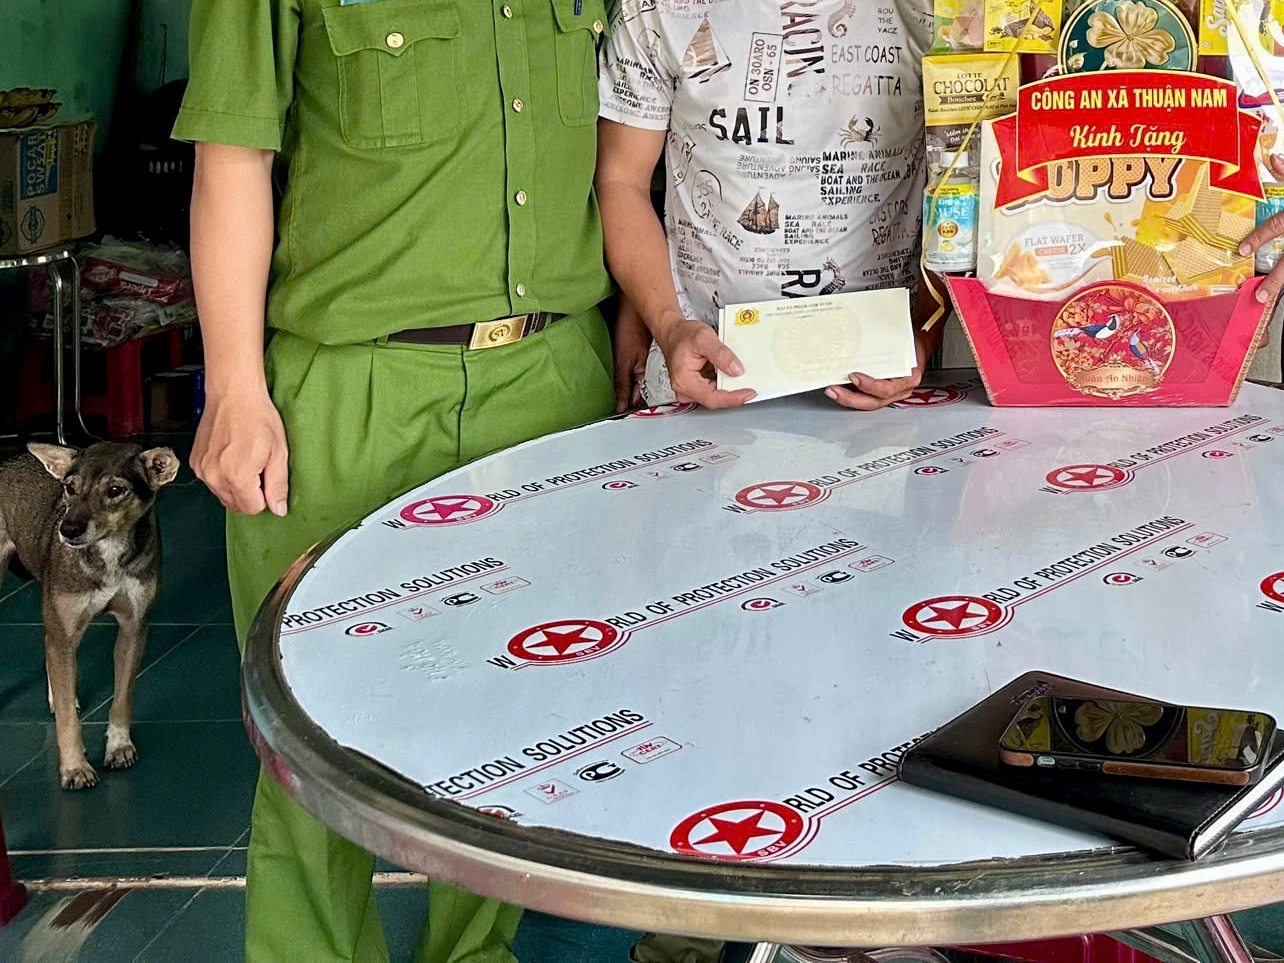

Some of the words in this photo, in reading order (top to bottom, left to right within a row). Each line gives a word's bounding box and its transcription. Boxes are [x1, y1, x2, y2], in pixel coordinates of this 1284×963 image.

[878, 17, 893, 25] THE
[831, 44, 861, 64] EAST
[864, 45, 902, 63] COAST
[831, 75, 902, 96] REGATTA
[933, 77, 1009, 95] CHOCOLAT
[1030, 87, 1076, 109] CÔNG
[1079, 90, 1102, 108] AN
[1106, 86, 1129, 108] XÃ
[1133, 87, 1187, 113] THUẬN
[1190, 89, 1227, 108] NAM
[710, 106, 794, 145] SAIL
[1070, 125, 1122, 149] Kính
[1129, 124, 1187, 155] Tặng
[823, 150, 865, 162] MARINE
[822, 164, 844, 174] SEA
[860, 161, 886, 174] RACE
[820, 175, 844, 185] BOAT
[846, 175, 863, 185] AND
[820, 186, 863, 196] SAILING
[822, 194, 881, 206] EXPERIENCE
[1024, 236, 1050, 247] FLAT
[1051, 234, 1084, 245] WAFER
[1069, 243, 1087, 254] 2X
[1143, 274, 1176, 284] Remixed
[1147, 431, 1211, 456] PROTECTION
[1204, 414, 1263, 438] SOLUTIONS
[839, 467, 861, 479] OF
[858, 445, 938, 472] PROTECTION
[930, 426, 998, 450] SOLUTIONS
[521, 481, 546, 493] OF
[546, 458, 638, 486] PROTECTION
[635, 439, 714, 463] SOLUTIONS
[1014, 576, 1040, 590] OF
[1034, 542, 1121, 580] PROTECTION
[1111, 515, 1186, 547] SOLUTIONS
[646, 599, 675, 615] OF
[672, 567, 776, 606] PROTECTION
[770, 538, 860, 572] SOLUTIONS
[282, 588, 401, 628] PROTECTION
[400, 557, 505, 593] SOLUTIONS
[522, 708, 645, 762] SOLUTIONS
[829, 770, 866, 791] OF
[757, 840, 787, 857] SBV
